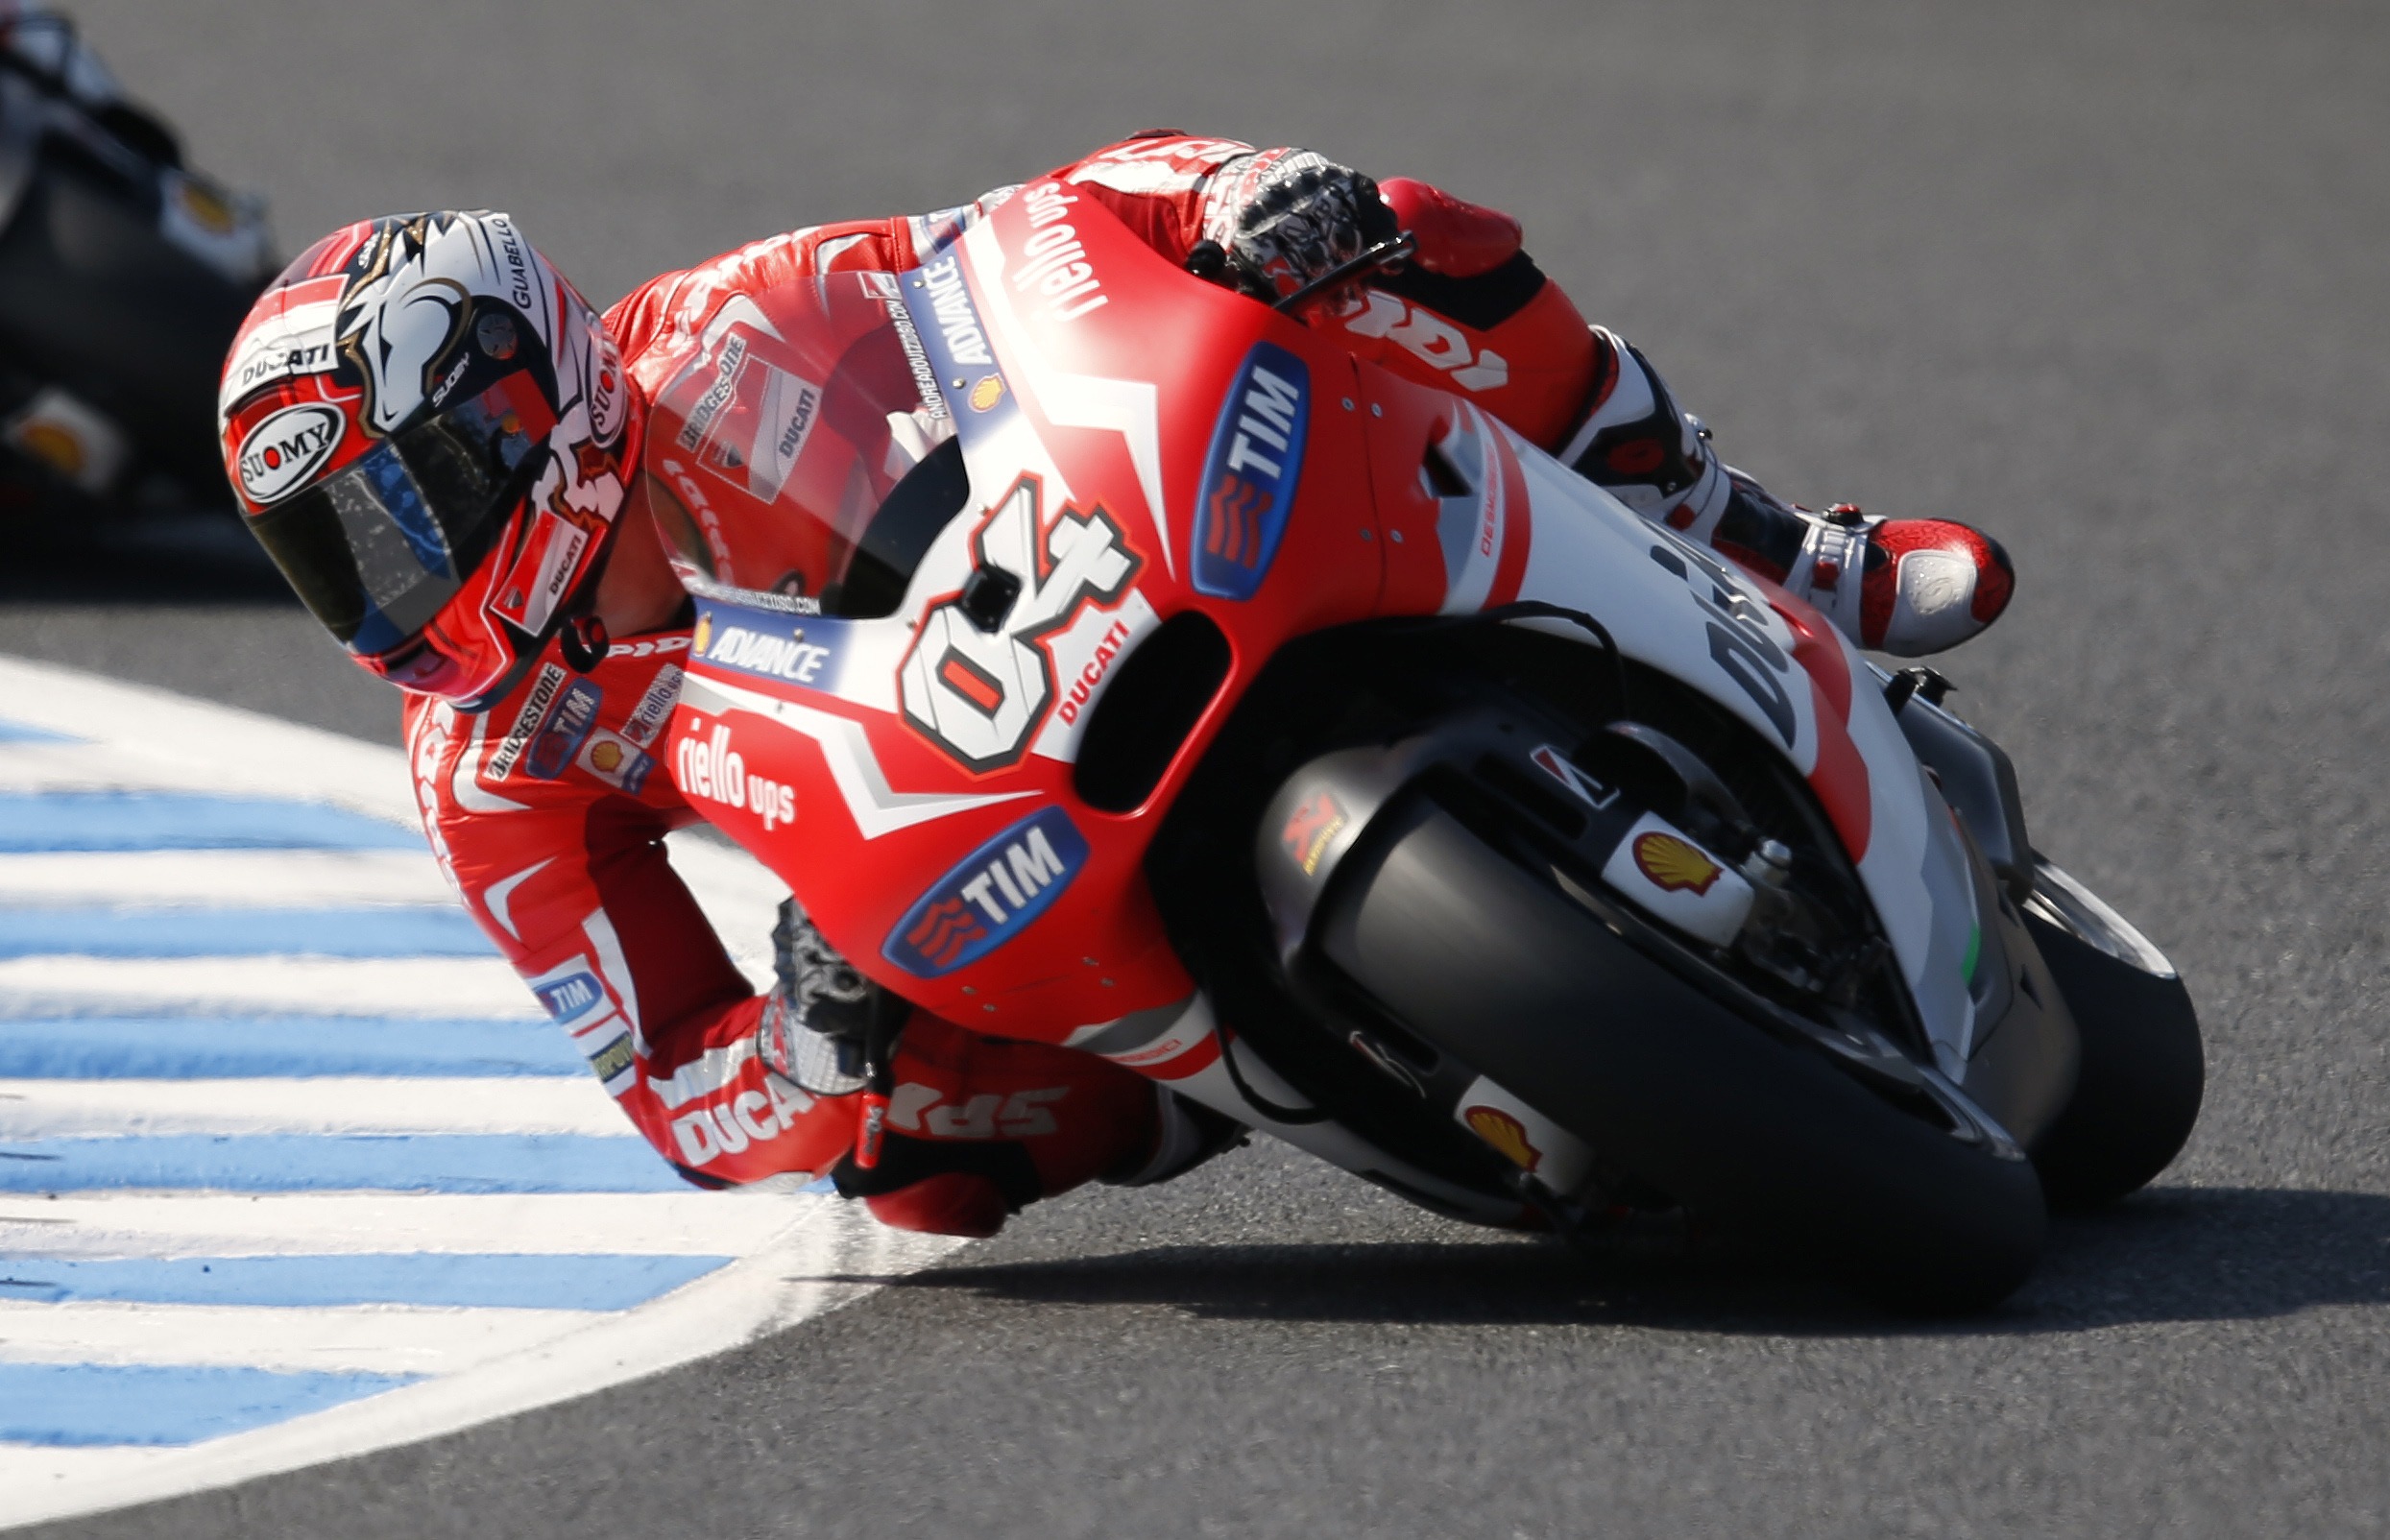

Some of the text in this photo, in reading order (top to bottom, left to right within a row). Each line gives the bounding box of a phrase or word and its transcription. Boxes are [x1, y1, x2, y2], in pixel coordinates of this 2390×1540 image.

[493, 218, 531, 309] GUABELLO
[1012, 181, 1109, 323] riello ups
[923, 255, 993, 364] ADVANCE
[242, 343, 329, 386] DUCATI
[591, 349, 618, 426] SUOM
[681, 337, 743, 449] BRIDGESONE
[240, 421, 327, 481] SUOMY
[779, 388, 816, 458] DUCATI
[1226, 365, 1300, 480] TIM
[548, 534, 583, 595] DUCATI
[707, 626, 831, 684] ADVANCE
[898, 472, 1147, 780] 04
[552, 687, 595, 736] TIM
[640, 686, 673, 726] riello
[1056, 620, 1130, 727] DUCATI
[490, 664, 563, 780] BRIDGESTONE
[678, 717, 746, 808] riello
[747, 774, 796, 831] ups
[961, 825, 1066, 925] TIM
[549, 978, 593, 1014] TIM
[672, 1076, 820, 1167] DUCA
